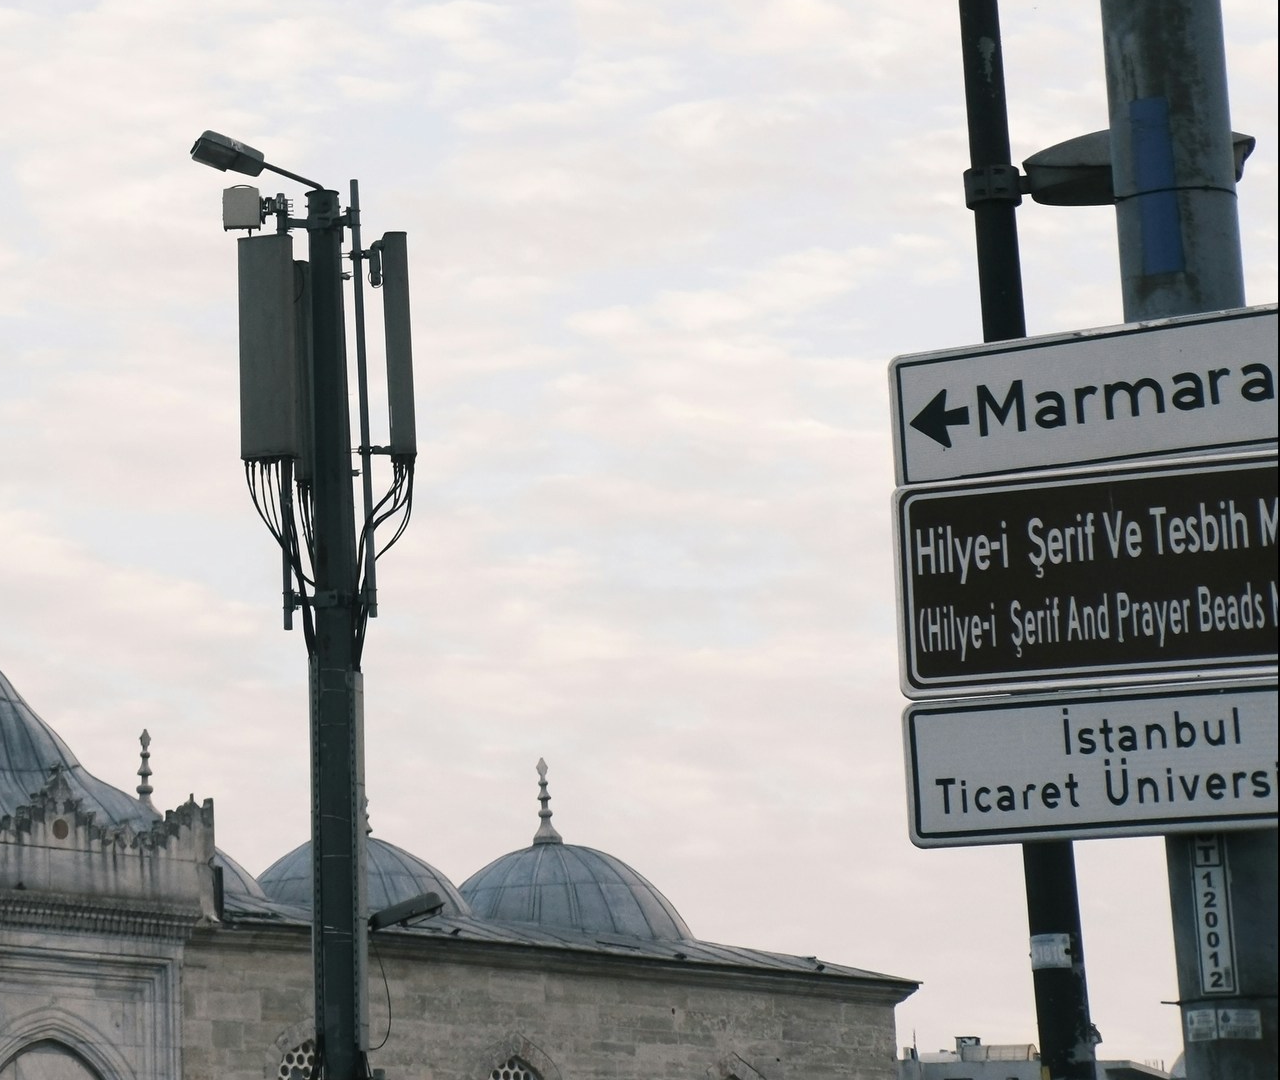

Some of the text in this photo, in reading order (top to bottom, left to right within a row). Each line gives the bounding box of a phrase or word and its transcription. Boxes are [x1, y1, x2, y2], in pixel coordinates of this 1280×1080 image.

[977, 363, 1275, 437] Marmara
[916, 521, 1009, 584] Hilye-i
[1028, 512, 1094, 578] Şerif
[1103, 510, 1142, 558] Ve
[1149, 500, 1249, 555] Tesbih
[919, 602, 997, 661] (Hilye-i
[1010, 597, 1059, 657] Şerif
[1067, 593, 1108, 641] And
[1117, 590, 1190, 647] Prayer
[1198, 582, 1265, 632] Beads
[1062, 707, 1240, 755] İstanbul
[935, 773, 1081, 814] Ticaret
[1203, 872, 1223, 988] 120012
